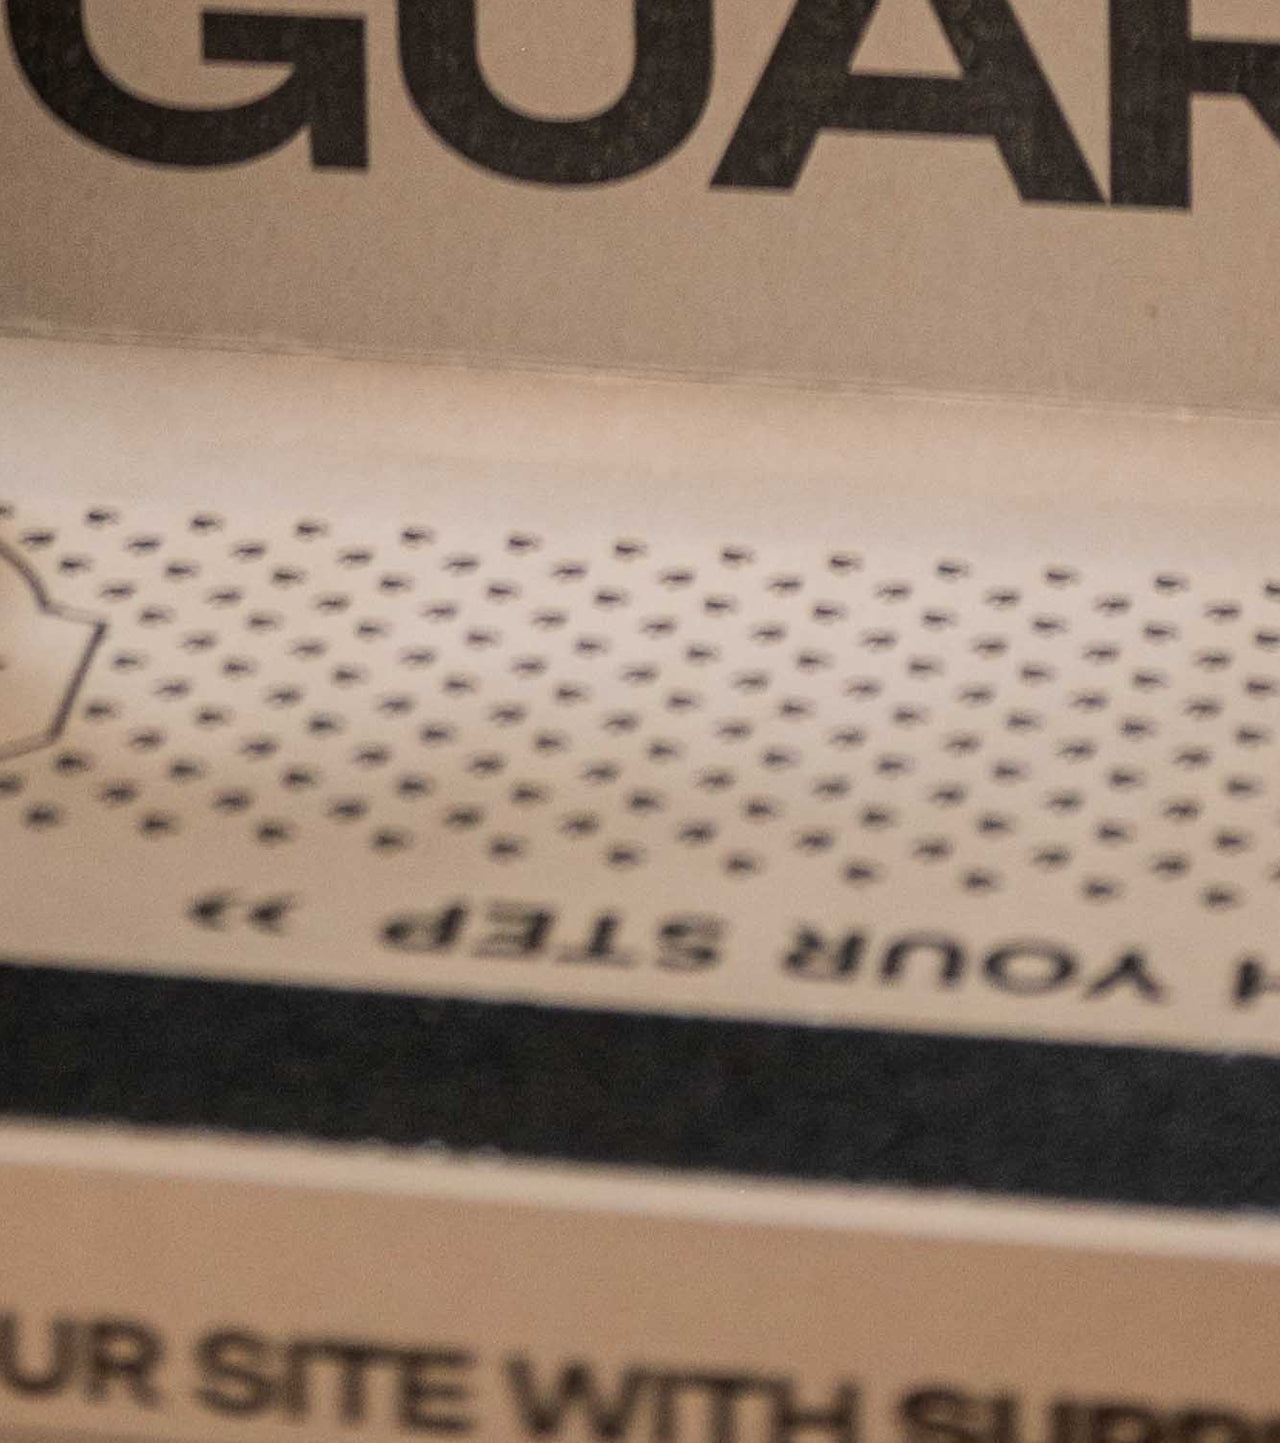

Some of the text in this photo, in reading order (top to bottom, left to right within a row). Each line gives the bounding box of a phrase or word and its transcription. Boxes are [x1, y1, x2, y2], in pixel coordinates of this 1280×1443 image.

[380, 896, 730, 972] STEP
[780, 922, 1167, 1002] YOUR
[194, 1322, 476, 1436] SITE
[508, 1350, 867, 1443] WITH
